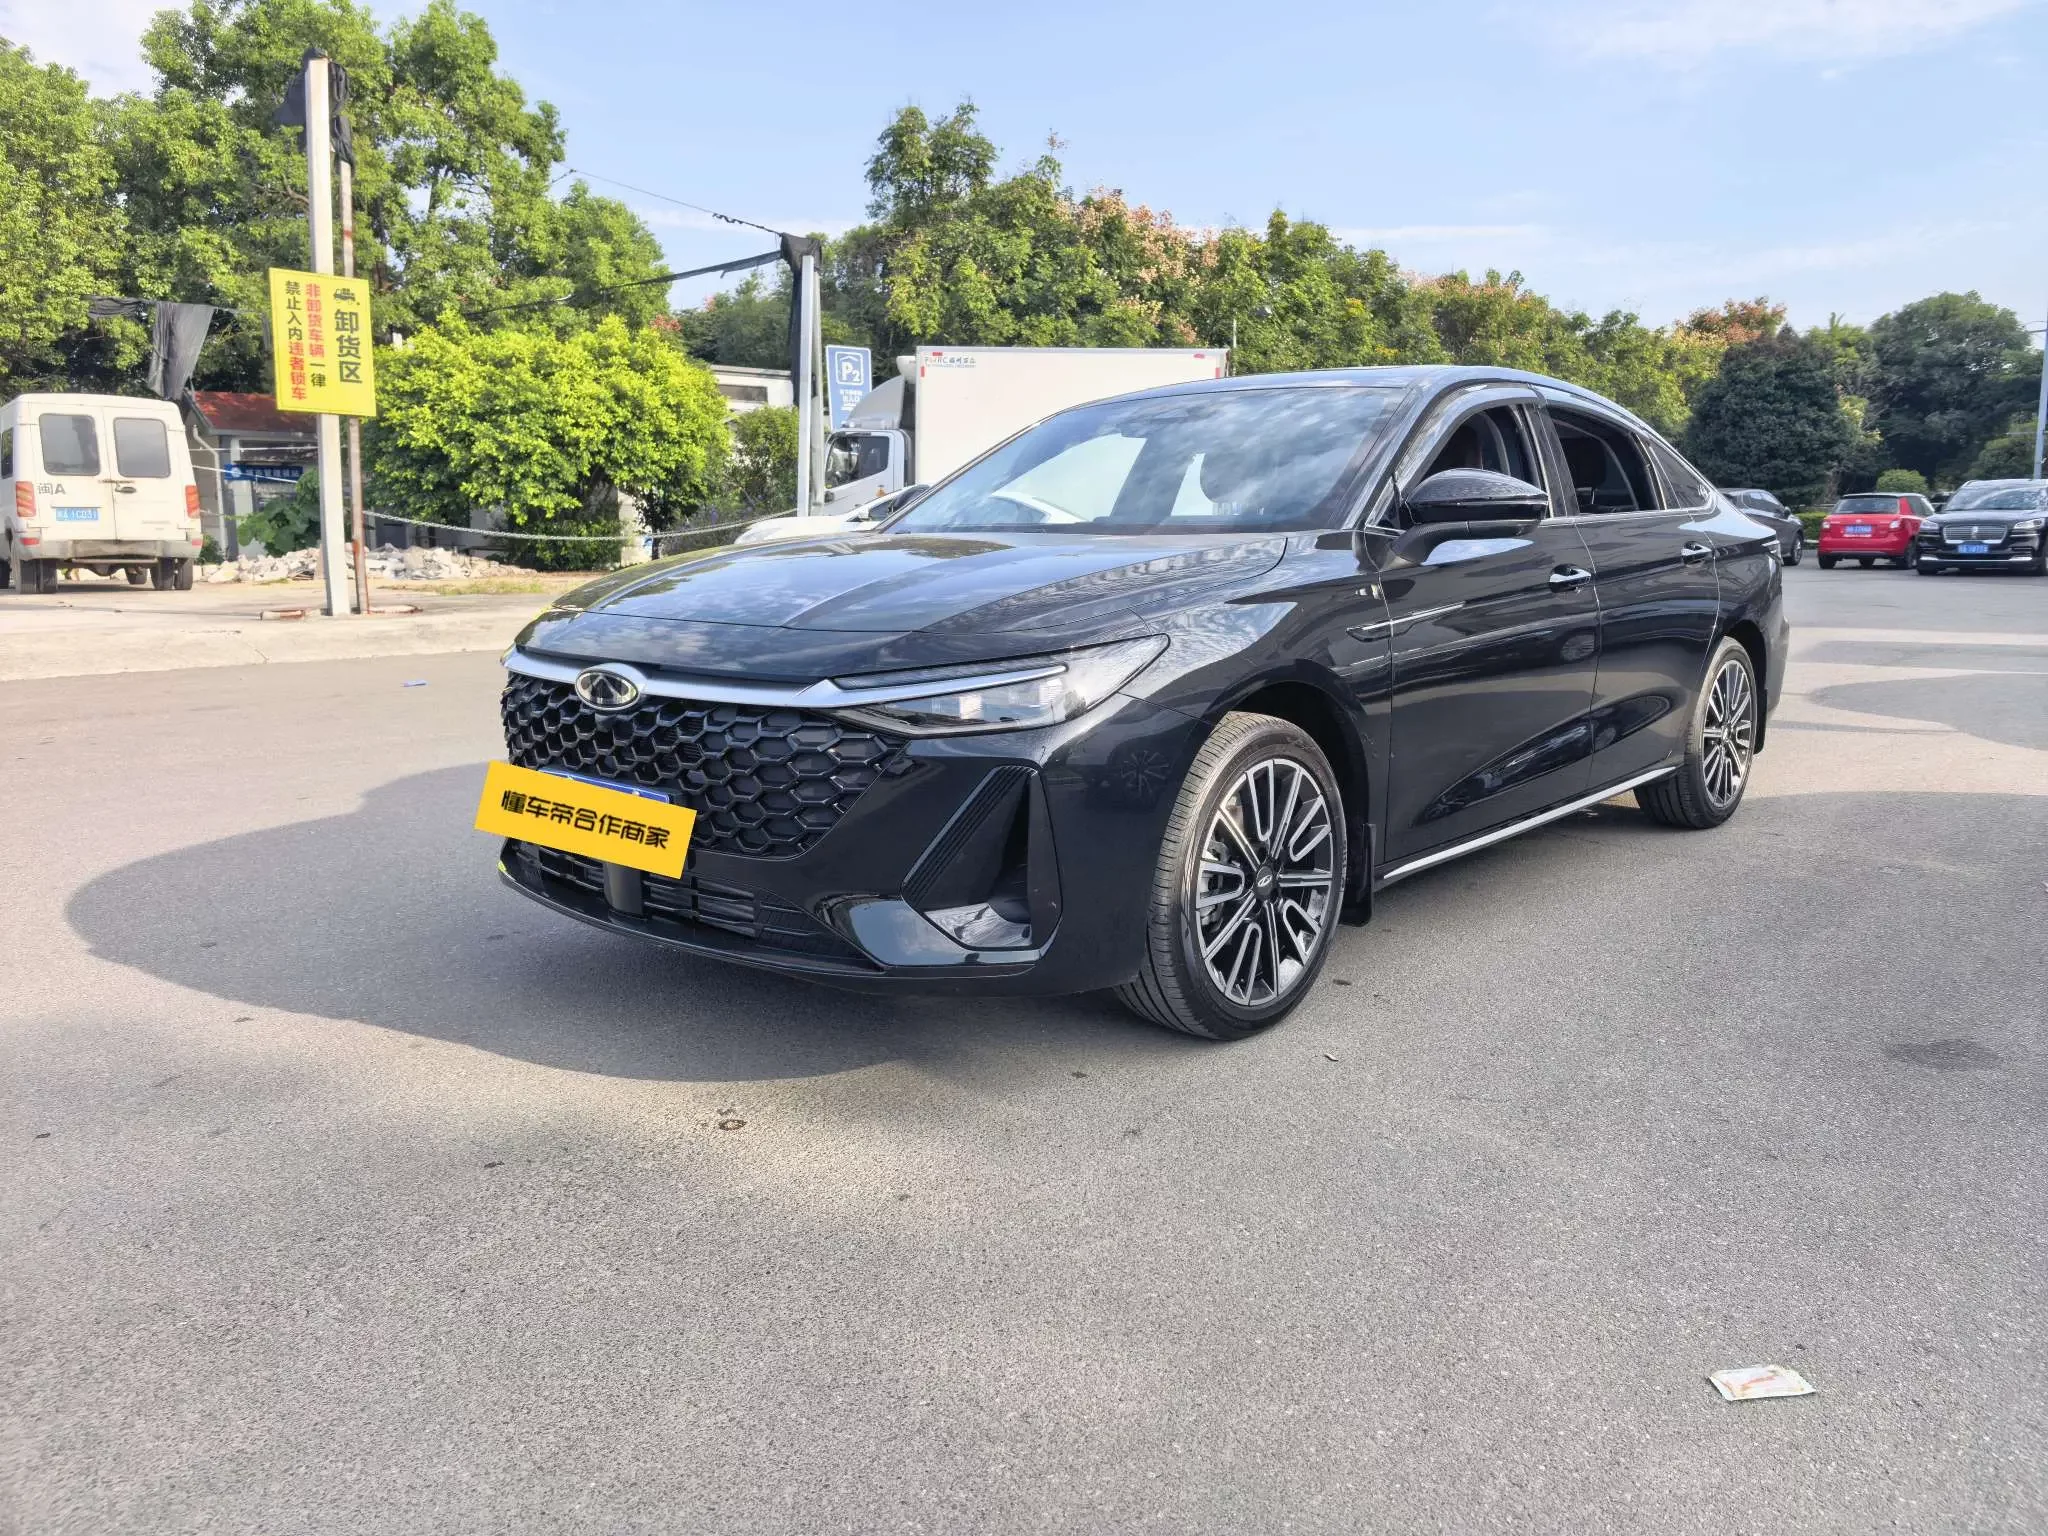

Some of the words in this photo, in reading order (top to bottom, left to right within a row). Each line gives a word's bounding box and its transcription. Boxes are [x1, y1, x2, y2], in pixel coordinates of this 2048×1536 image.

[285, 280, 307, 401] 禁止入内违者锁车
[306, 283, 326, 387] 非卸货车辆一律
[334, 309, 362, 384] 卸货区
[38, 482, 66, 495] 闽A
